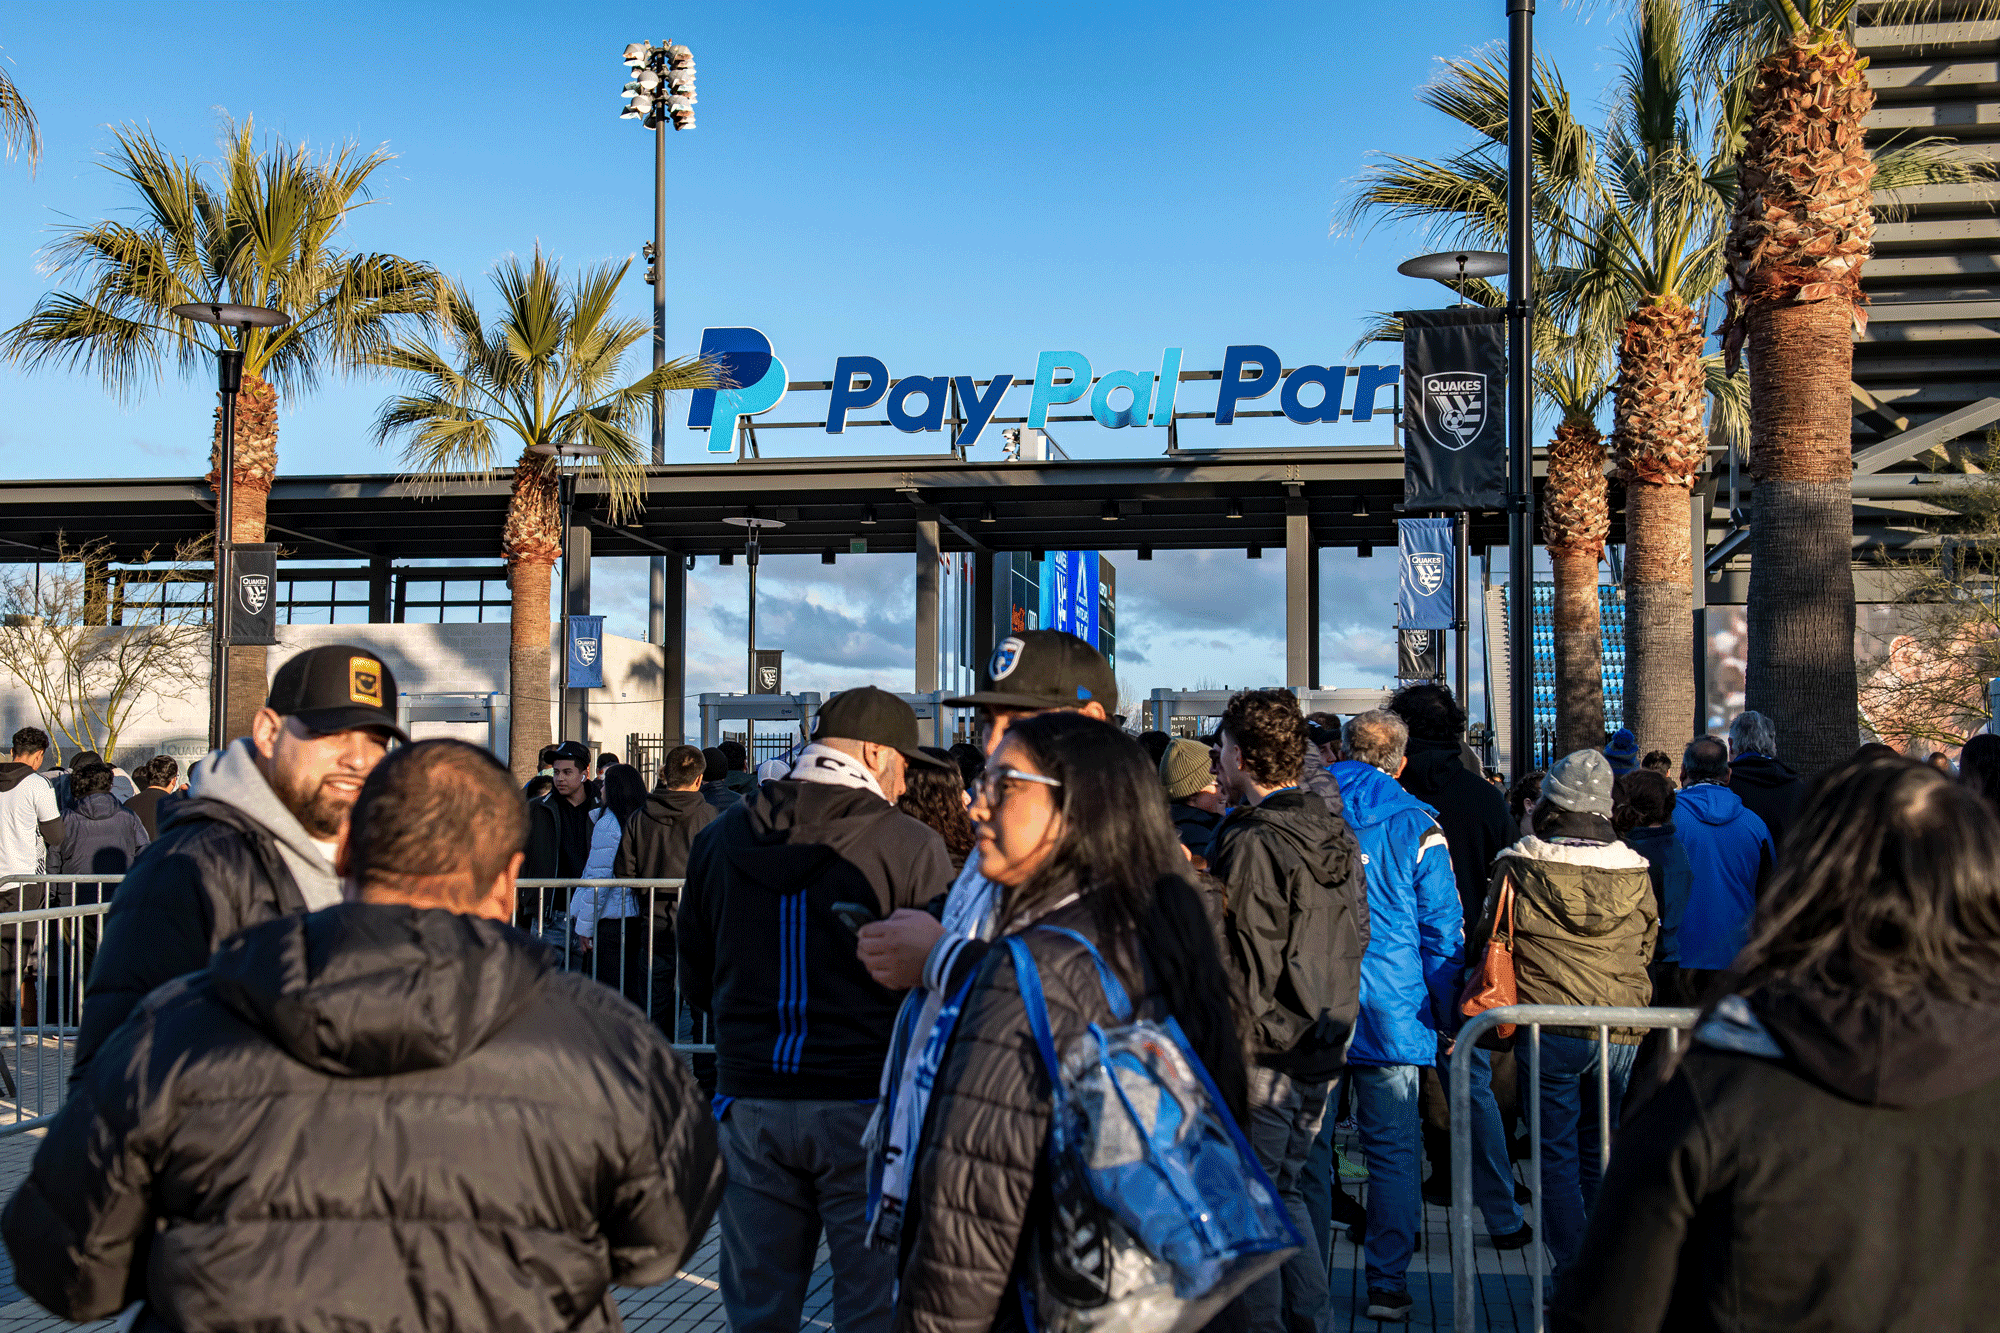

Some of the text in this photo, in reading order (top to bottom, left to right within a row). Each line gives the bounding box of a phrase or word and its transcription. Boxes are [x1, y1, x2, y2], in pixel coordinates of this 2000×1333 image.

[1215, 344, 1404, 425] Par
[1427, 379, 1481, 392] QUAKES
[1411, 556, 1441, 564] QUAKES
[242, 577, 267, 585] QUAKES
